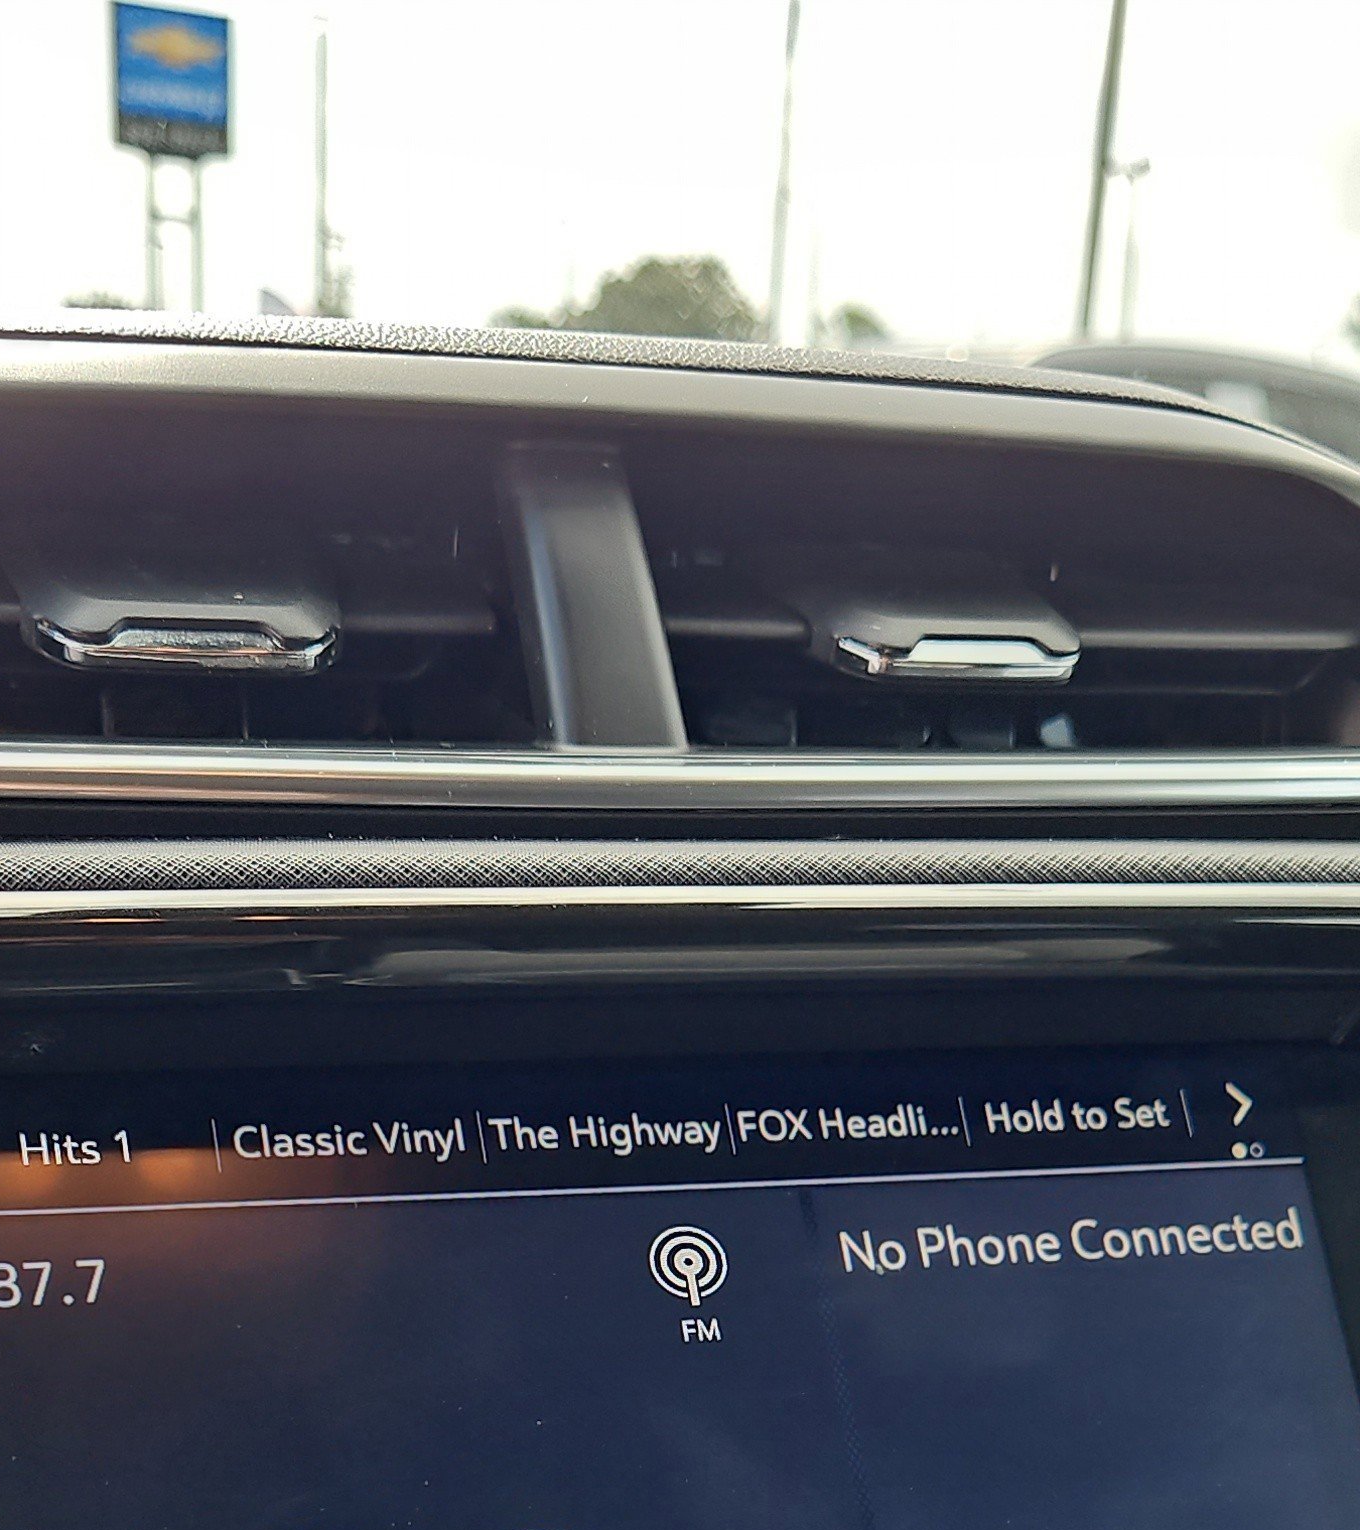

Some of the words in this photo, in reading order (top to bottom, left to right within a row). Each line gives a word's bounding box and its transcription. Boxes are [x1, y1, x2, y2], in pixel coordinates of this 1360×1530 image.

[488, 1117, 558, 1151] The
[569, 1111, 721, 1155] Highway
[737, 1108, 814, 1142] FOX
[819, 1102, 960, 1140] Headli...
[985, 1098, 1066, 1134] Hold
[1070, 1102, 1108, 1130] to
[1116, 1097, 1171, 1129] Set
[19, 1132, 102, 1166] Hits
[116, 1130, 133, 1162] 1
[233, 1125, 367, 1160] Classic
[373, 1117, 466, 1162] Vinyl
[840, 1230, 907, 1273] No
[917, 1224, 1063, 1270] Phone
[1070, 1208, 1304, 1263] Connected
[681, 1318, 722, 1343] FM
